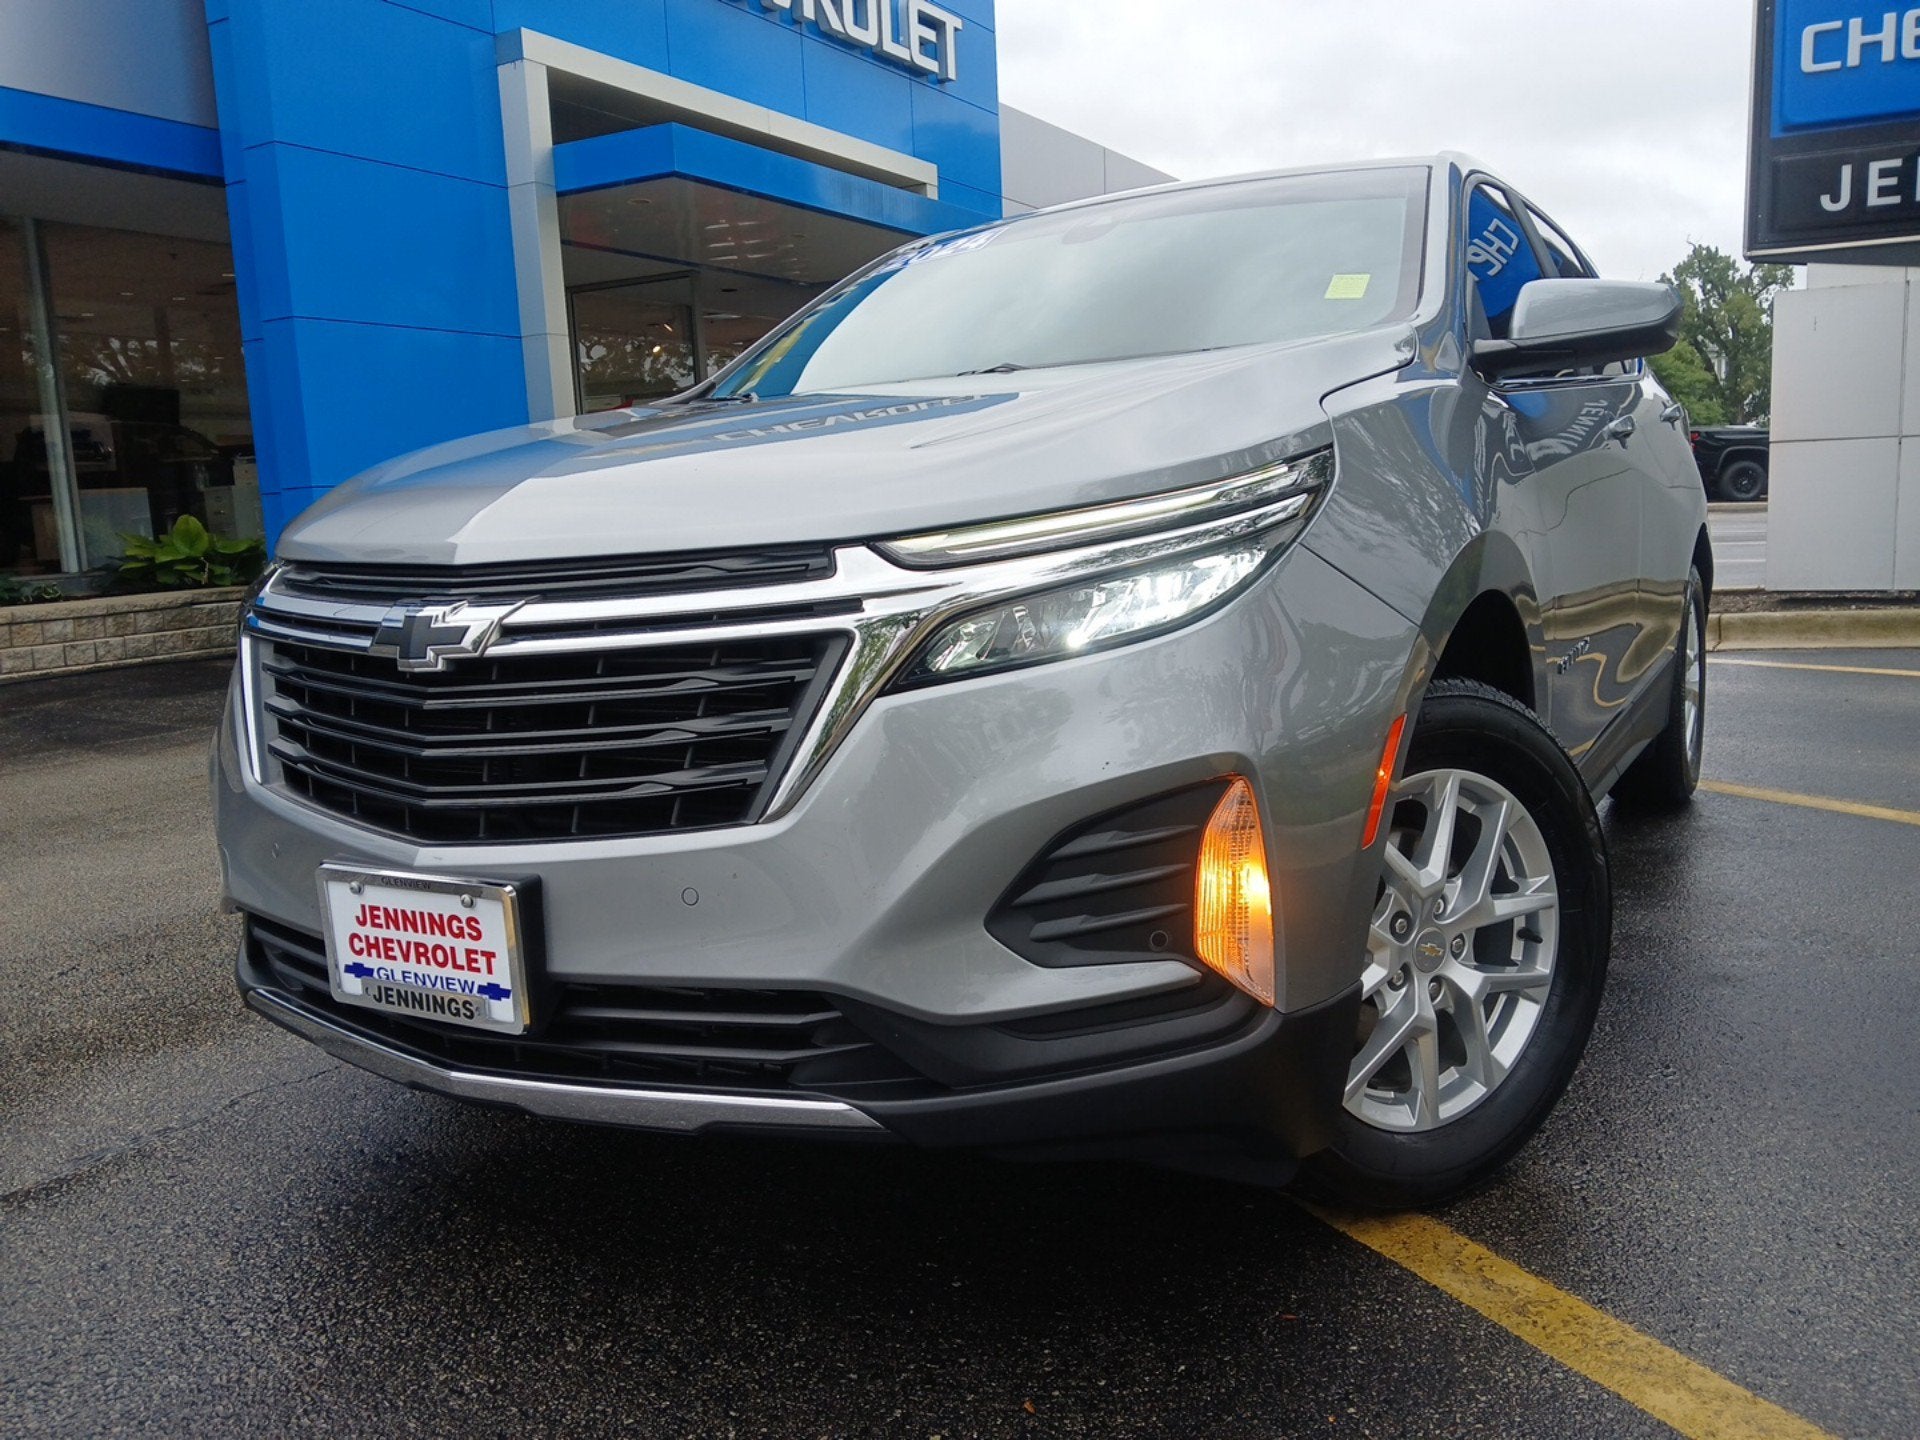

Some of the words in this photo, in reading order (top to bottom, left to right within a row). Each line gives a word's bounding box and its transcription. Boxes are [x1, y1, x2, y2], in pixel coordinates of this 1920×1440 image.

[1820, 157, 1920, 212] JE
[355, 904, 482, 942] JENNINGS
[348, 933, 496, 975] CHEVROLET
[376, 967, 475, 994] GLENVIEW
[373, 985, 475, 1020] JENNINGS
